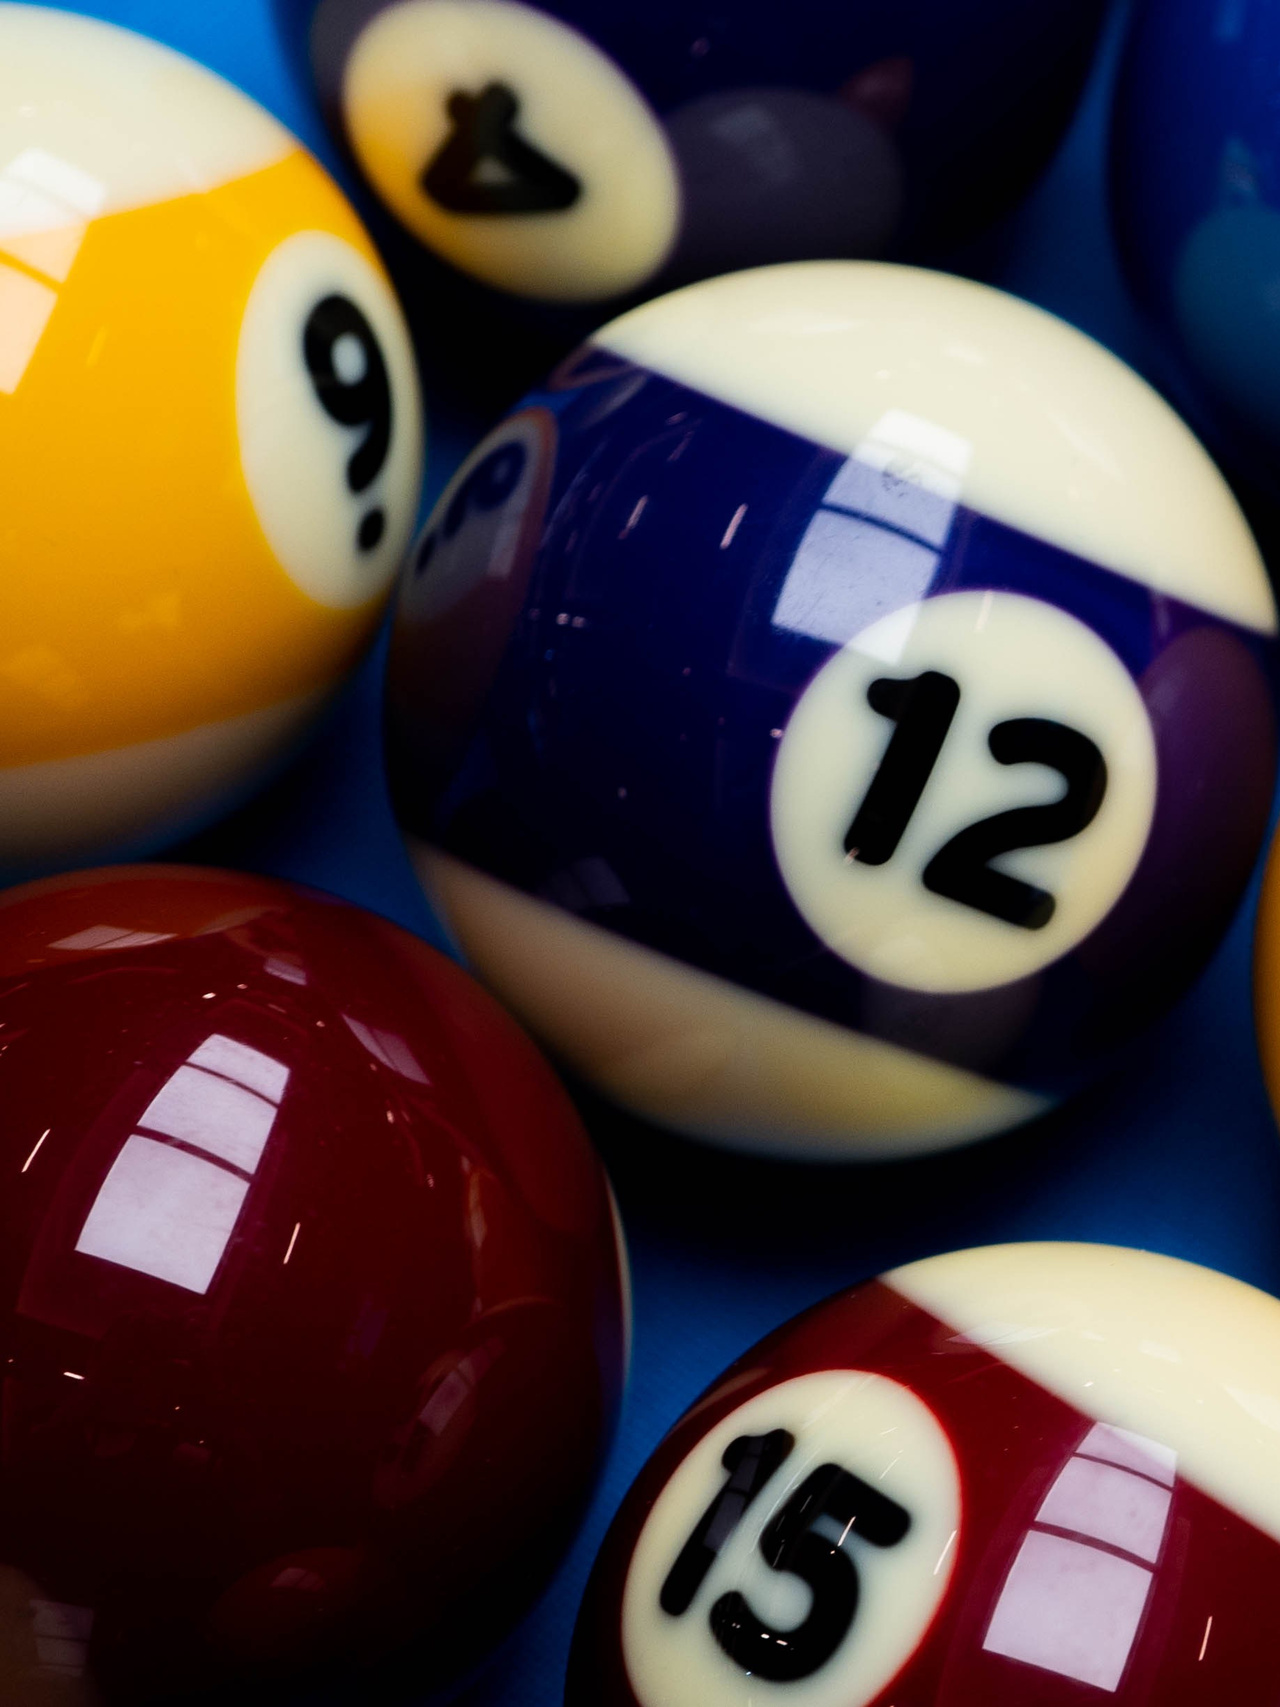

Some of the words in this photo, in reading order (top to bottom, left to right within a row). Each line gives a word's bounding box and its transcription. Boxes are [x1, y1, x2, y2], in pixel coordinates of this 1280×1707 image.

[420, 83, 582, 216] 4
[843, 671, 1108, 931] 12
[659, 1429, 912, 1684] 15
